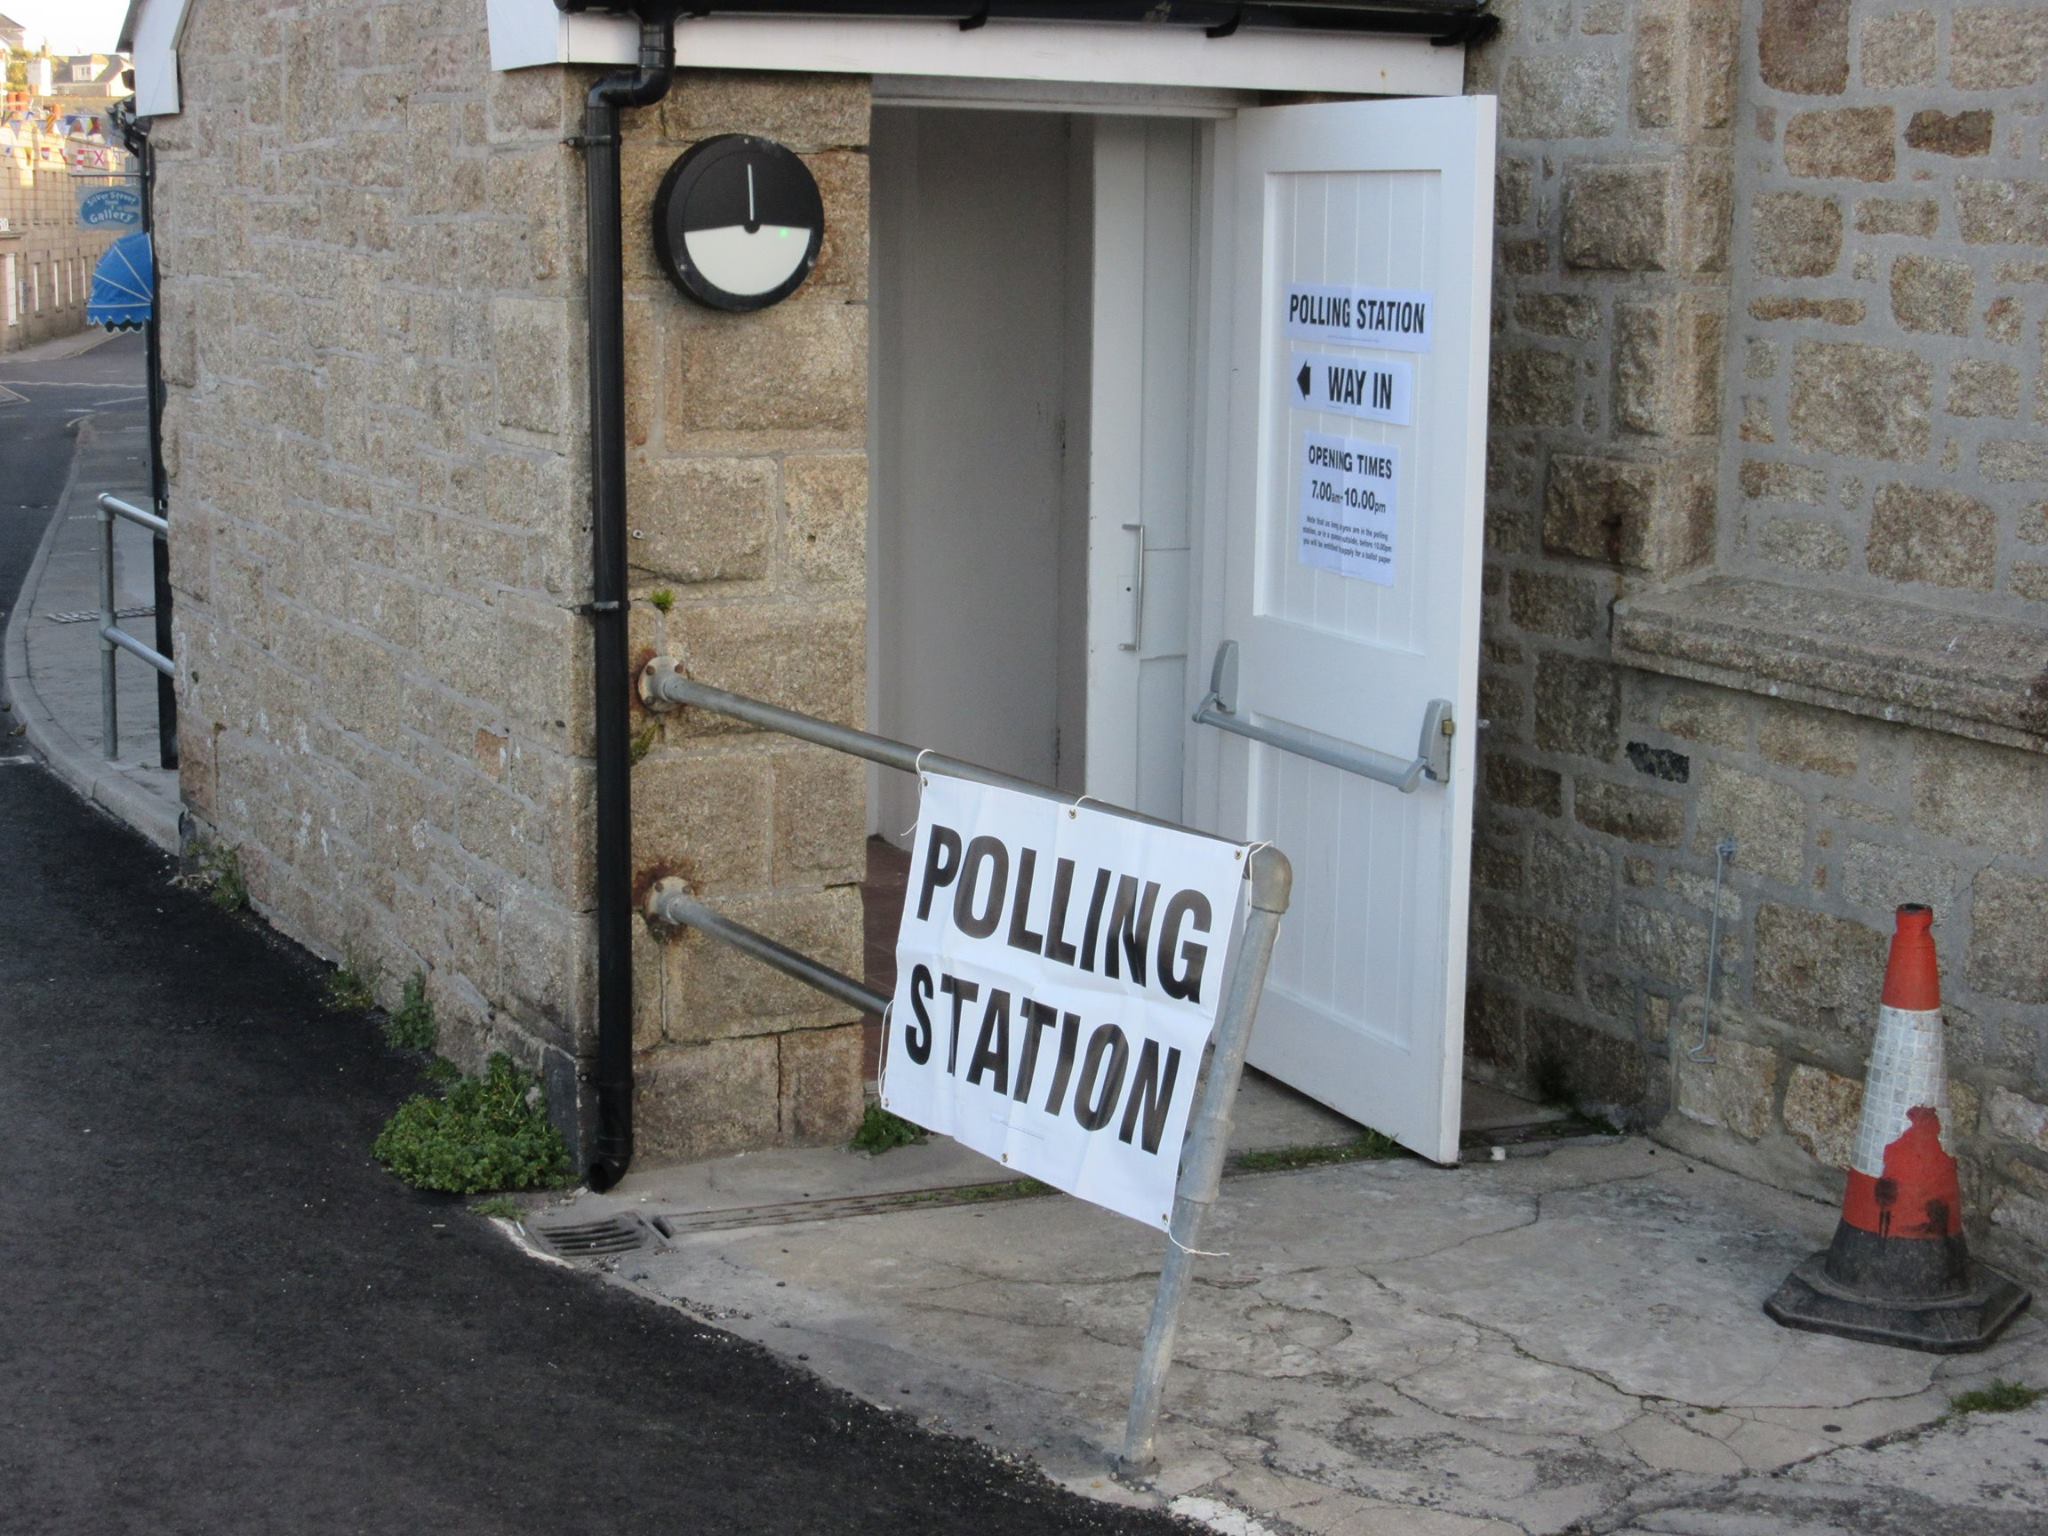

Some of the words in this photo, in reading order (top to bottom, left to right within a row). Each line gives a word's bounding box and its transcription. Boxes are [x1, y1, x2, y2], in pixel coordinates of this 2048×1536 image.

[90, 209, 133, 223] Gallery
[1289, 294, 1351, 328] POLLING
[1357, 299, 1425, 334] STATION
[1328, 366, 1367, 406] WAY
[1373, 372, 1392, 410] IN
[1309, 445, 1353, 473] OPENING
[1357, 454, 1392, 480] TIMES
[917, 824, 1212, 1004] POLLING
[905, 963, 1182, 1156] STATION
